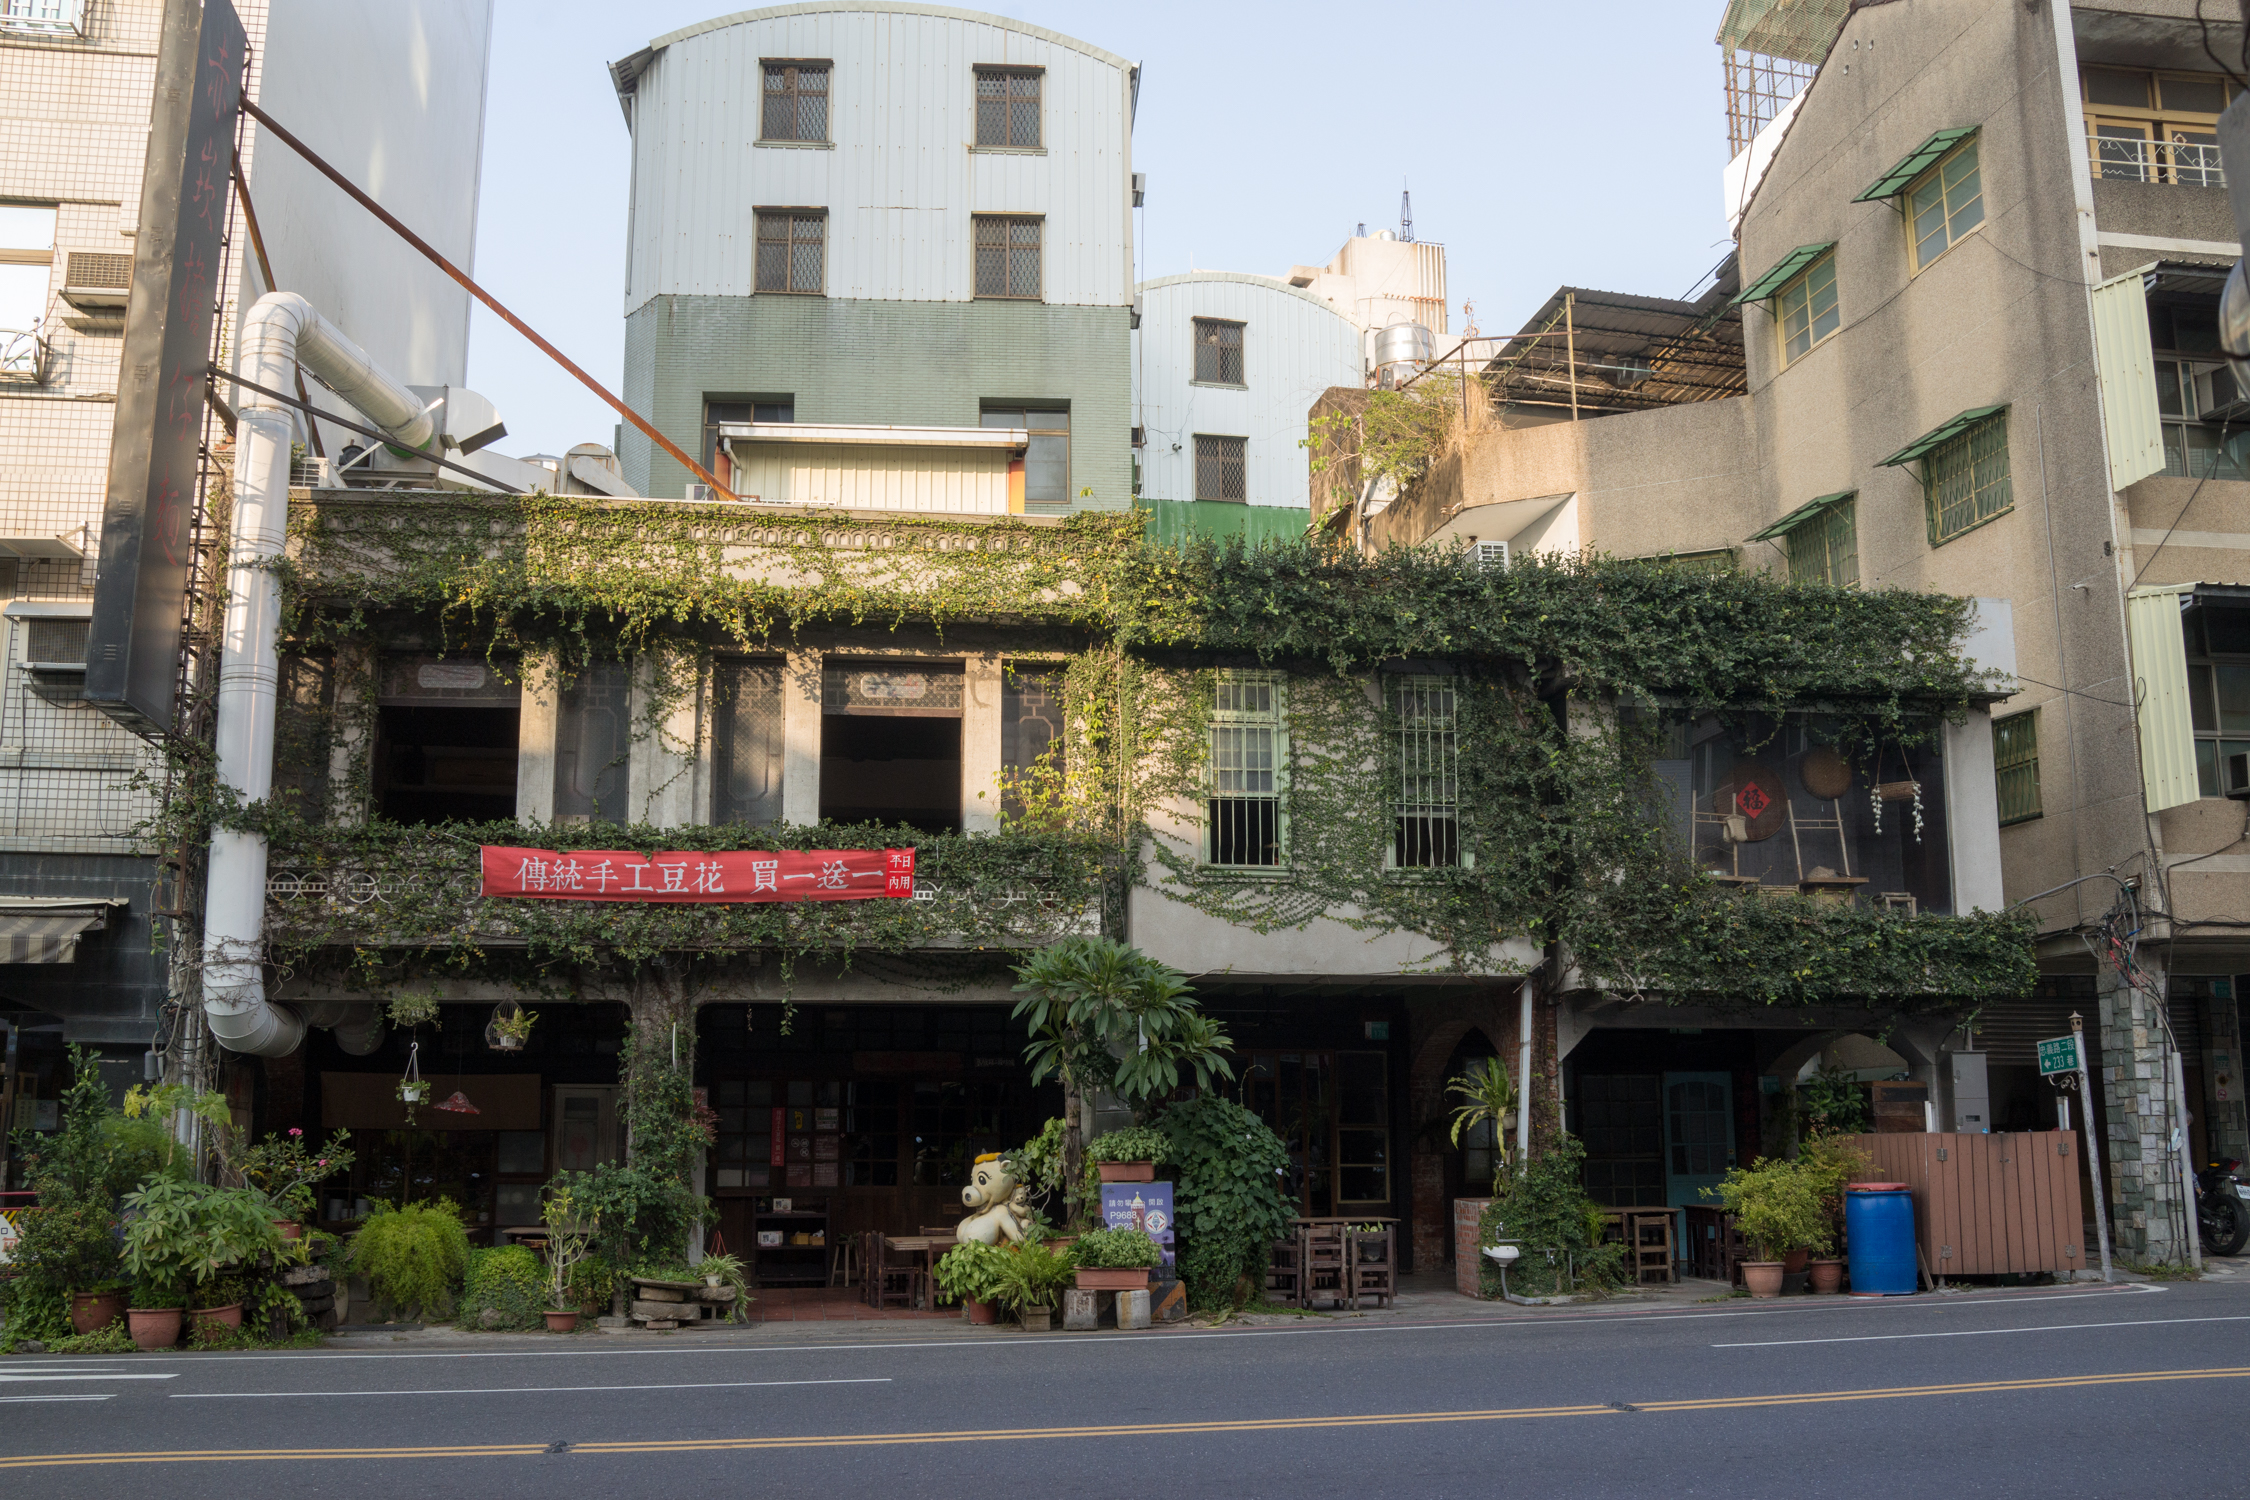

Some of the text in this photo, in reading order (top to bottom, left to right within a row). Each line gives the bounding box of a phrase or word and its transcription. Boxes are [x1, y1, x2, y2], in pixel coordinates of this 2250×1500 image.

[1743, 789, 1763, 810] 福
[889, 854, 911, 869] 平日
[513, 857, 884, 893] 傳統手工豆花 買一送一
[2039, 1039, 2075, 1057] 忠義路二段
[2053, 1054, 2075, 1069] 233 巷
[1110, 1211, 1137, 1220] P9688
